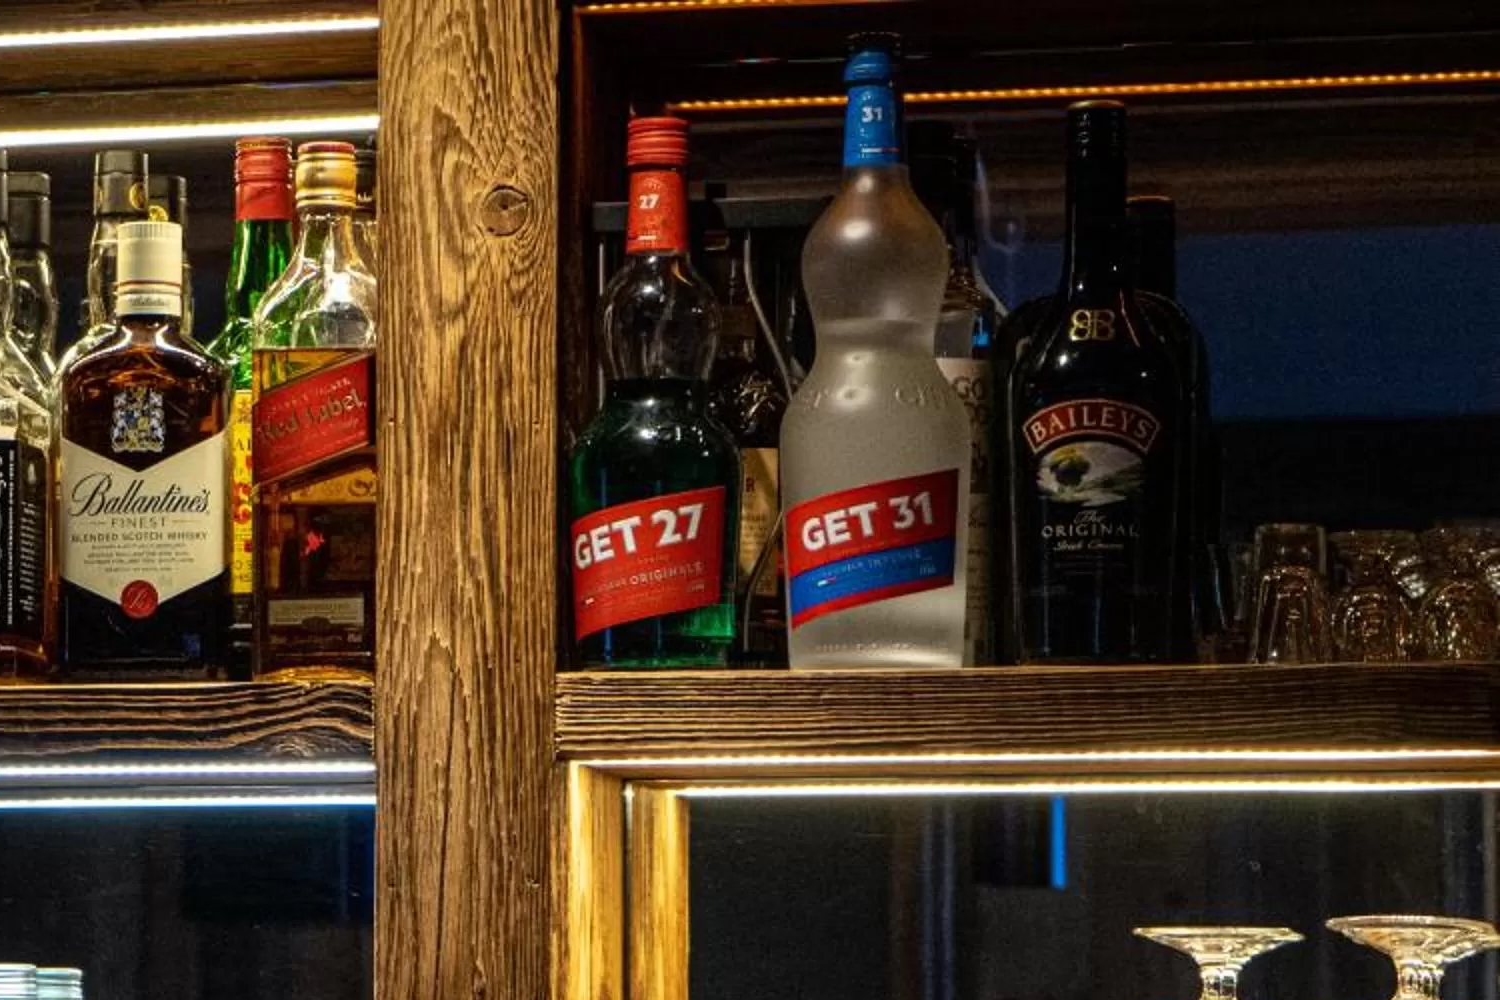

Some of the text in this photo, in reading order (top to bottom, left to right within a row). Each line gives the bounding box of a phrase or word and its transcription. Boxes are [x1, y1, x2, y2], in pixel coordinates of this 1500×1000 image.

[861, 106, 883, 123] 31
[639, 194, 660, 209] 27
[1030, 404, 1149, 445] BAILEYS
[69, 472, 211, 517] Ballantine's
[111, 516, 167, 529] FINEST
[802, 501, 878, 551] GET
[889, 491, 933, 530] 31
[71, 531, 208, 543] BLENDED SCOTCH WHISKY
[574, 515, 642, 570] GET
[651, 503, 705, 548] 27
[1041, 524, 1140, 538] ORIGINAL
